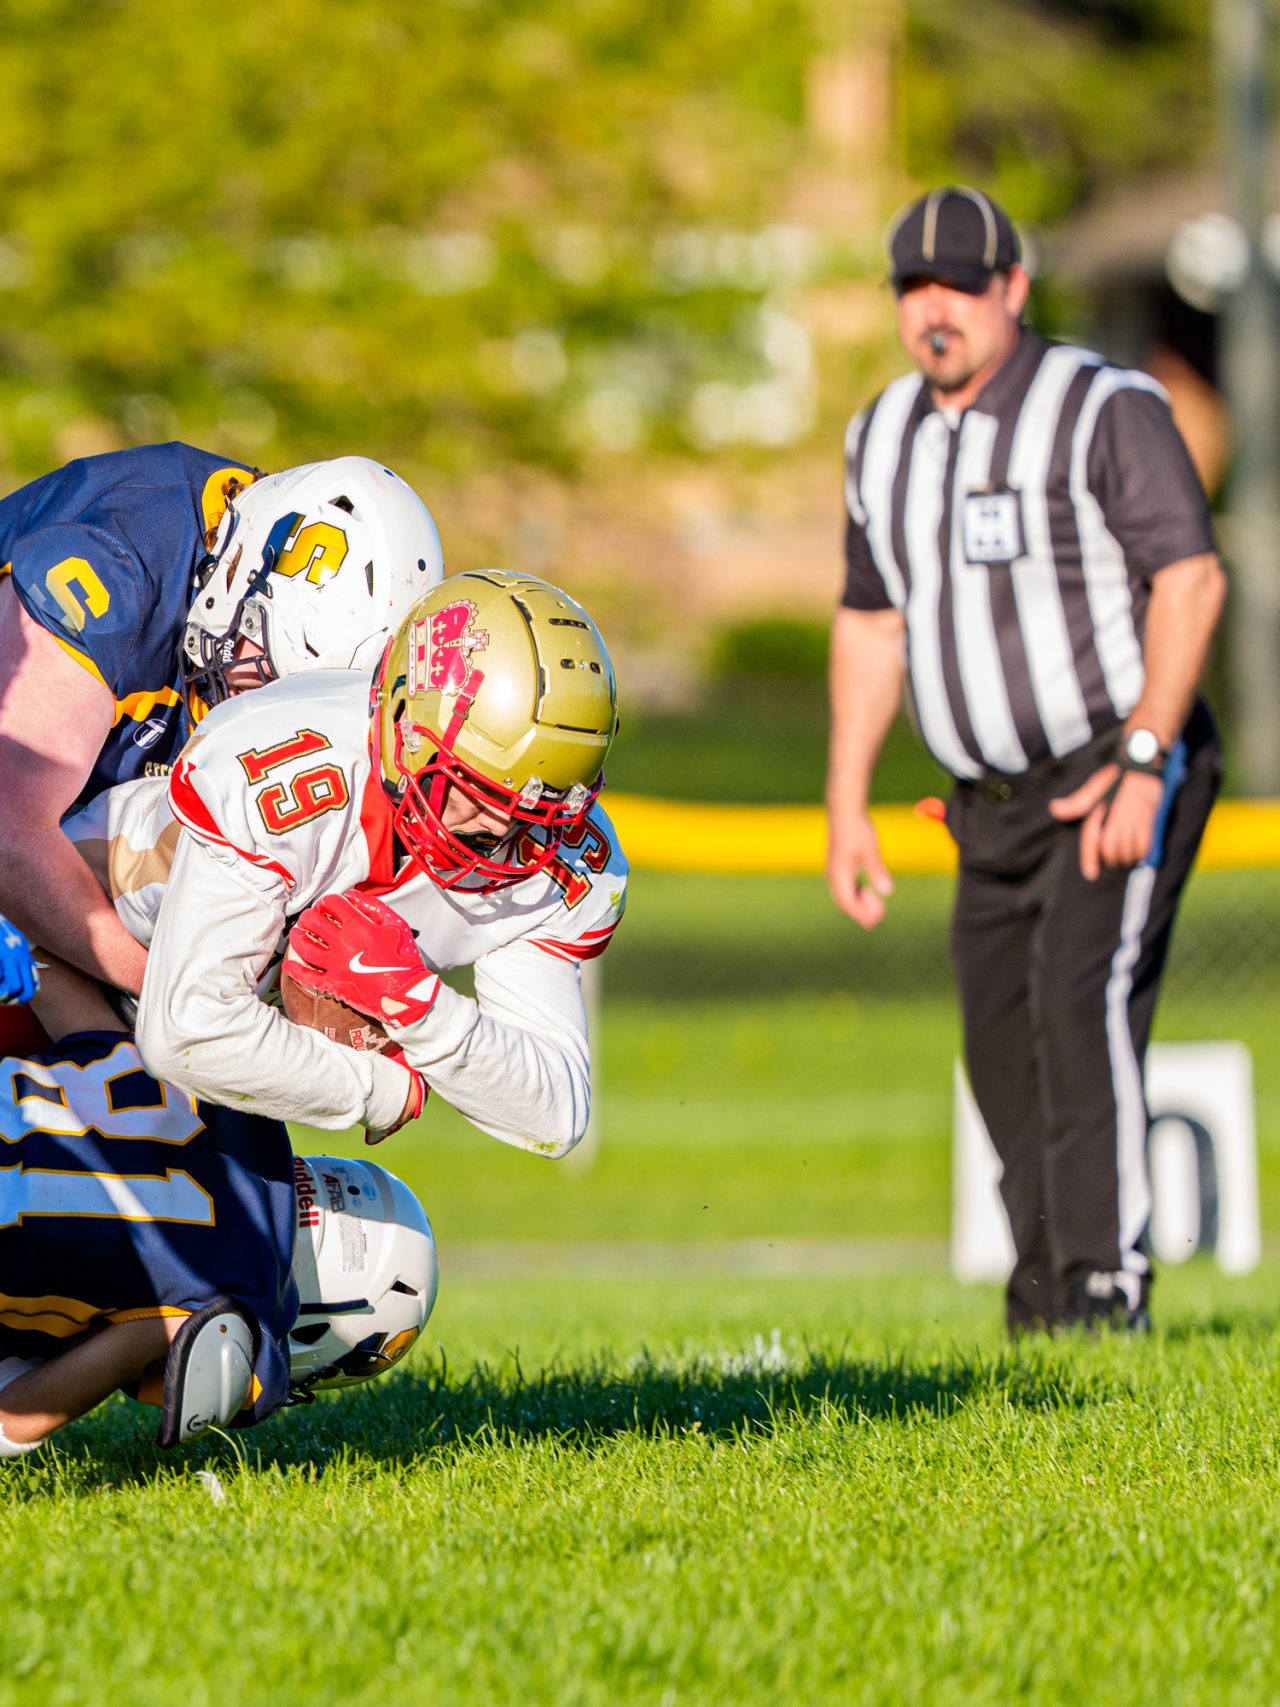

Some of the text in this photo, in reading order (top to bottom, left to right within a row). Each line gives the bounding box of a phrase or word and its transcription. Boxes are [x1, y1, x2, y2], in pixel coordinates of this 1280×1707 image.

[261, 511, 350, 587] S
[222, 638, 236, 664] Ridd
[236, 728, 350, 836] 19
